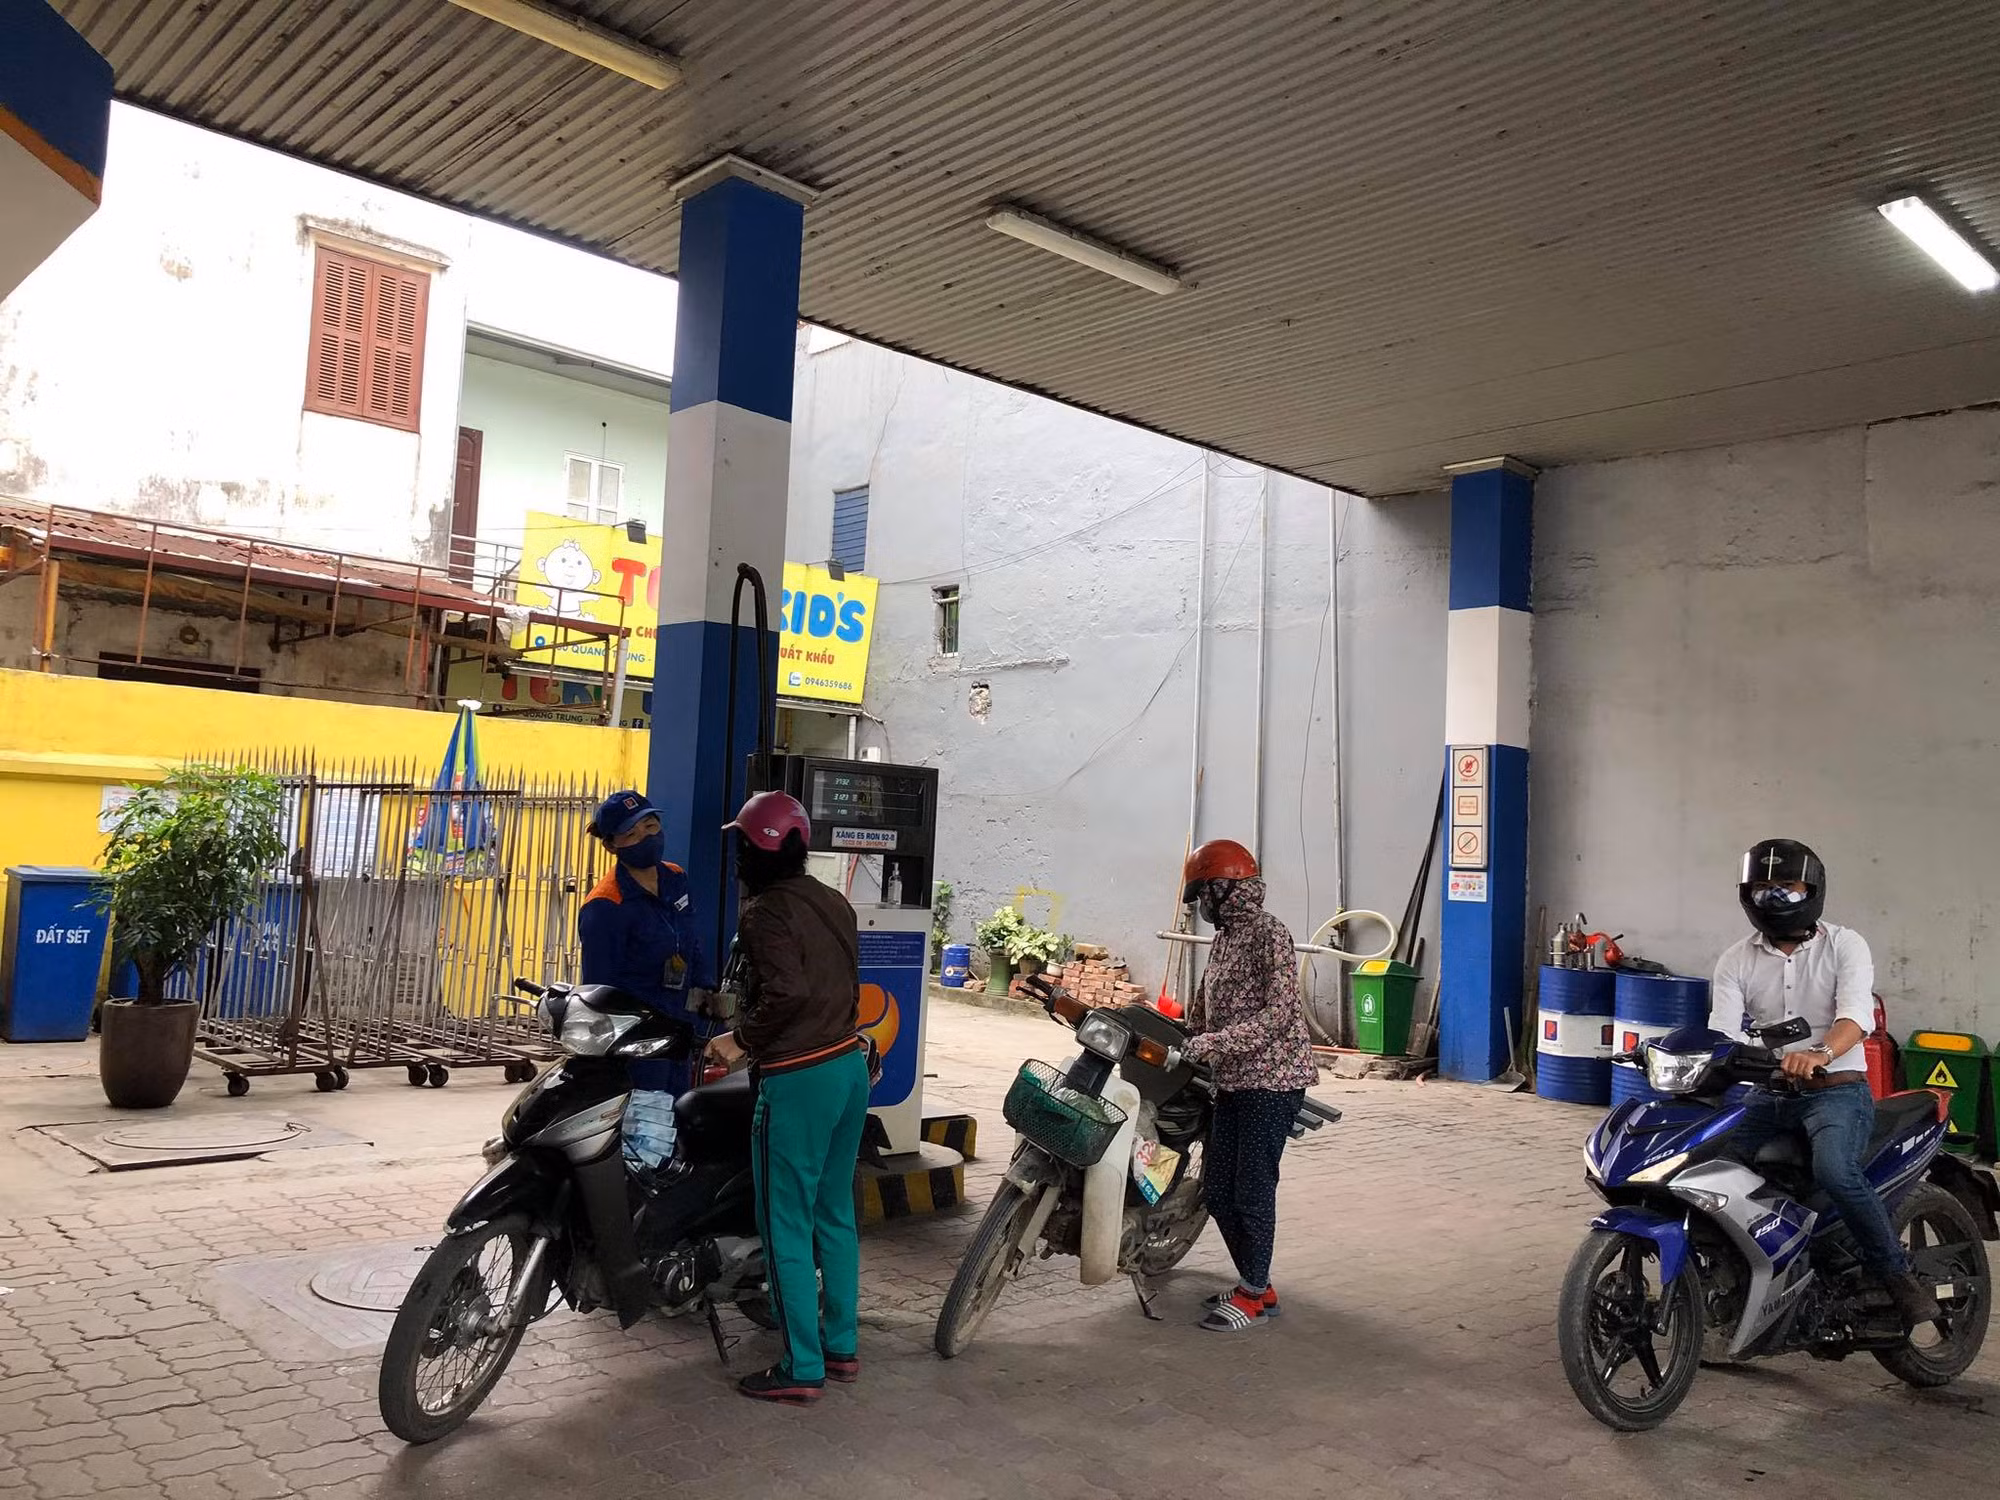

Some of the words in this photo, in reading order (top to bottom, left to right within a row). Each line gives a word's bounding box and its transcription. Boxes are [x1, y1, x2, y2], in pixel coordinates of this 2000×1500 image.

[780, 644, 802, 660] UẤT
[806, 647, 835, 665] KHẨU
[804, 677, 853, 690] 0946359686
[556, 713, 583, 723] TRUNG
[857, 832, 865, 840] E5
[866, 832, 881, 841] RON
[36, 923, 65, 944] ĐẤT
[66, 925, 91, 944] SÉT
[1643, 1148, 1675, 1166] 150
[1754, 1216, 1781, 1239] 150
